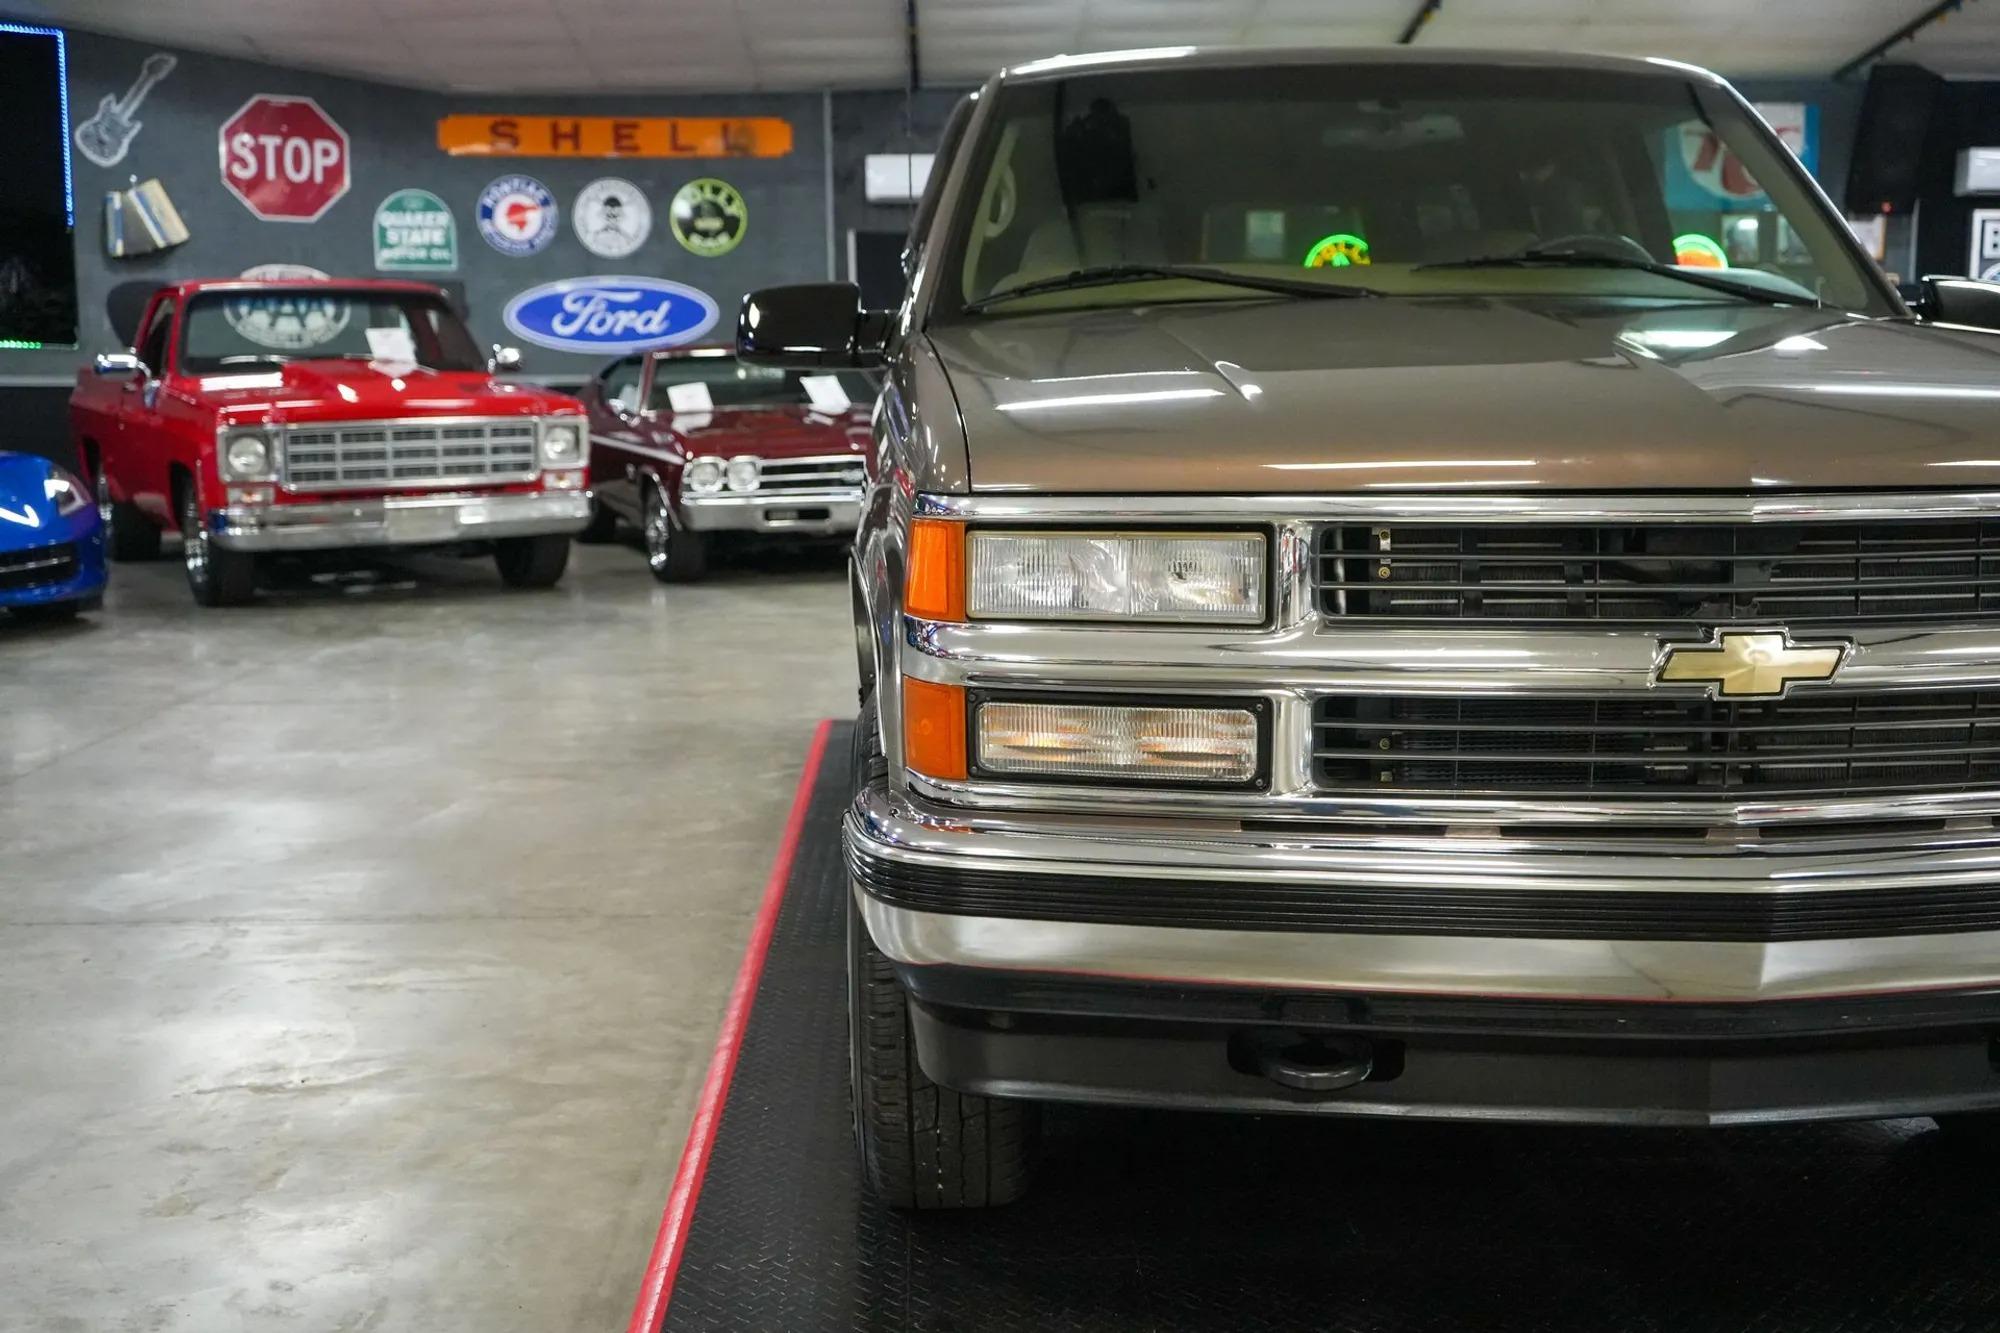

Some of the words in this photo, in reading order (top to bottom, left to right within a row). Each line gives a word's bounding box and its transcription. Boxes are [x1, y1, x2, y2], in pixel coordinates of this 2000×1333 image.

[489, 119, 748, 153] SHELL
[231, 132, 340, 185] STOP
[385, 228, 447, 246] STATE
[551, 289, 671, 337] Ford
